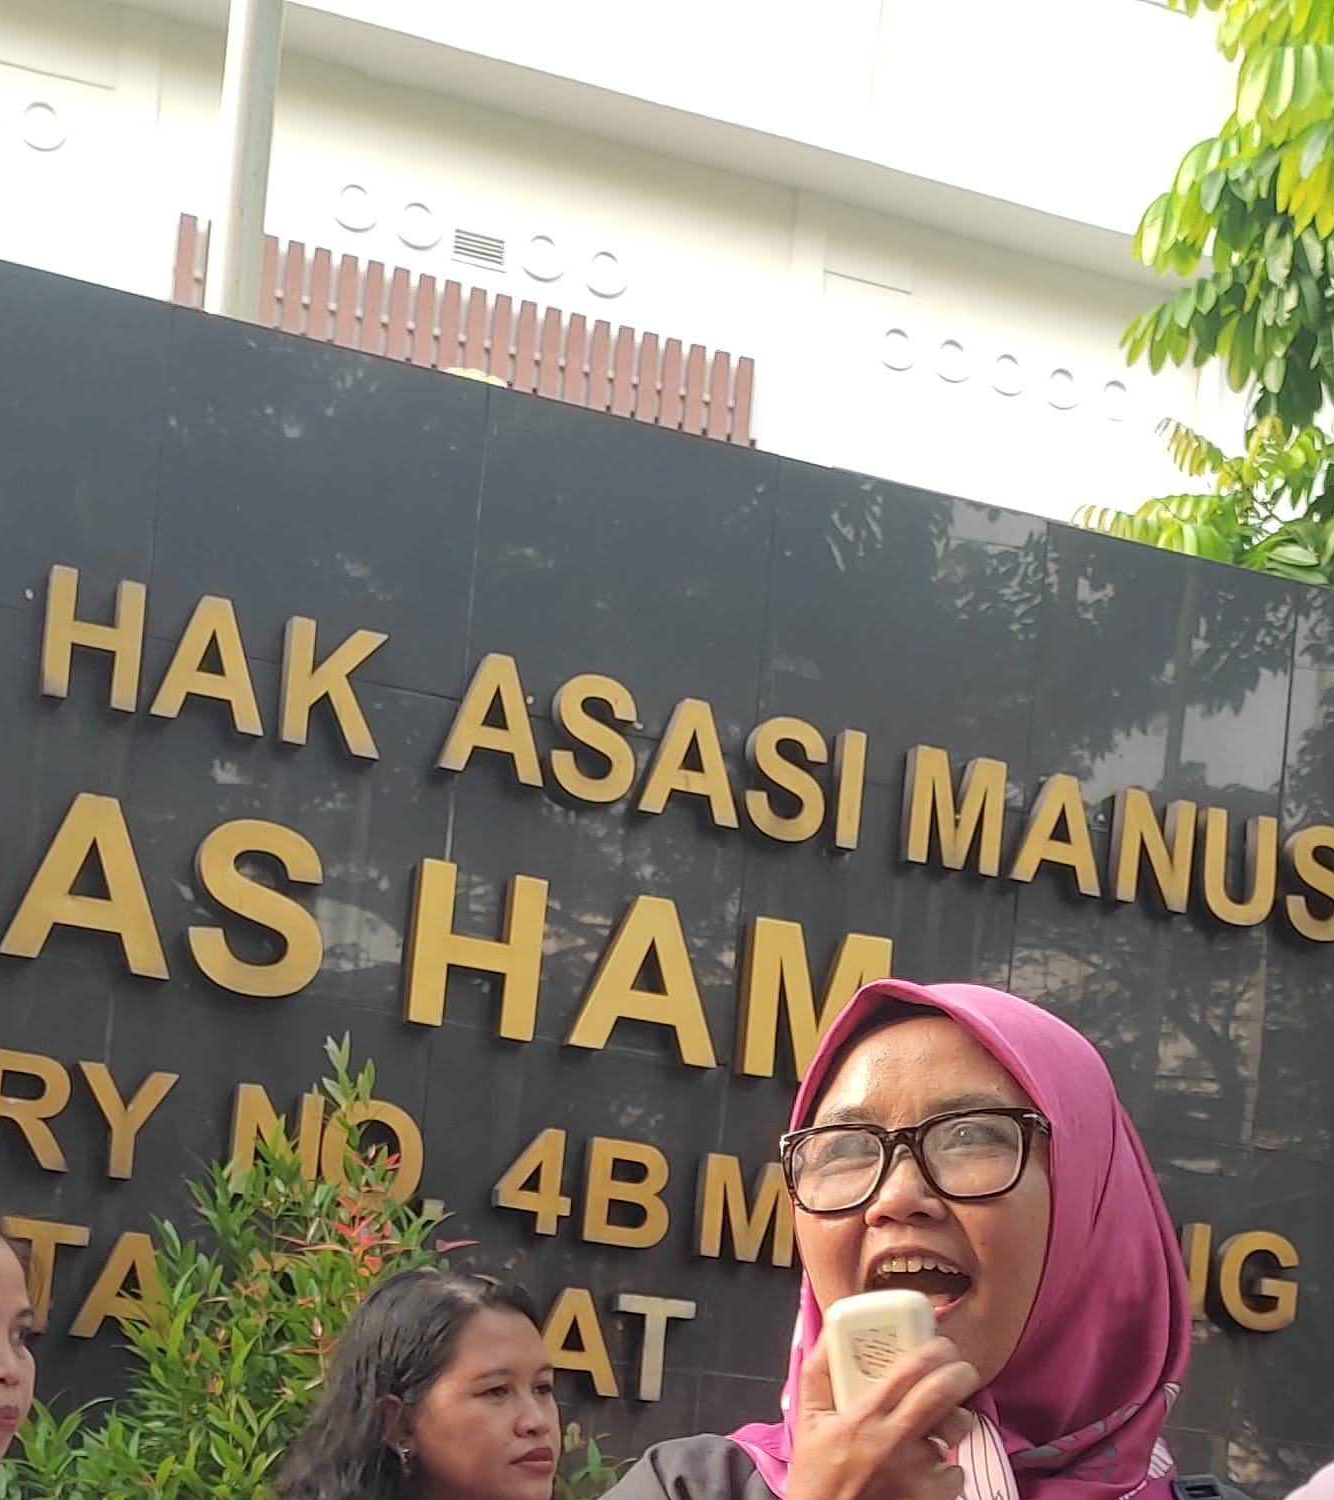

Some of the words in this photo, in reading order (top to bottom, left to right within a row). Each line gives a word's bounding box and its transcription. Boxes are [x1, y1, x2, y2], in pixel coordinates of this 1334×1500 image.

[40, 564, 388, 760] HAK
[437, 652, 867, 851] ASASI
[403, 857, 893, 1079] HAM
[492, 1128, 669, 1249] 4B
